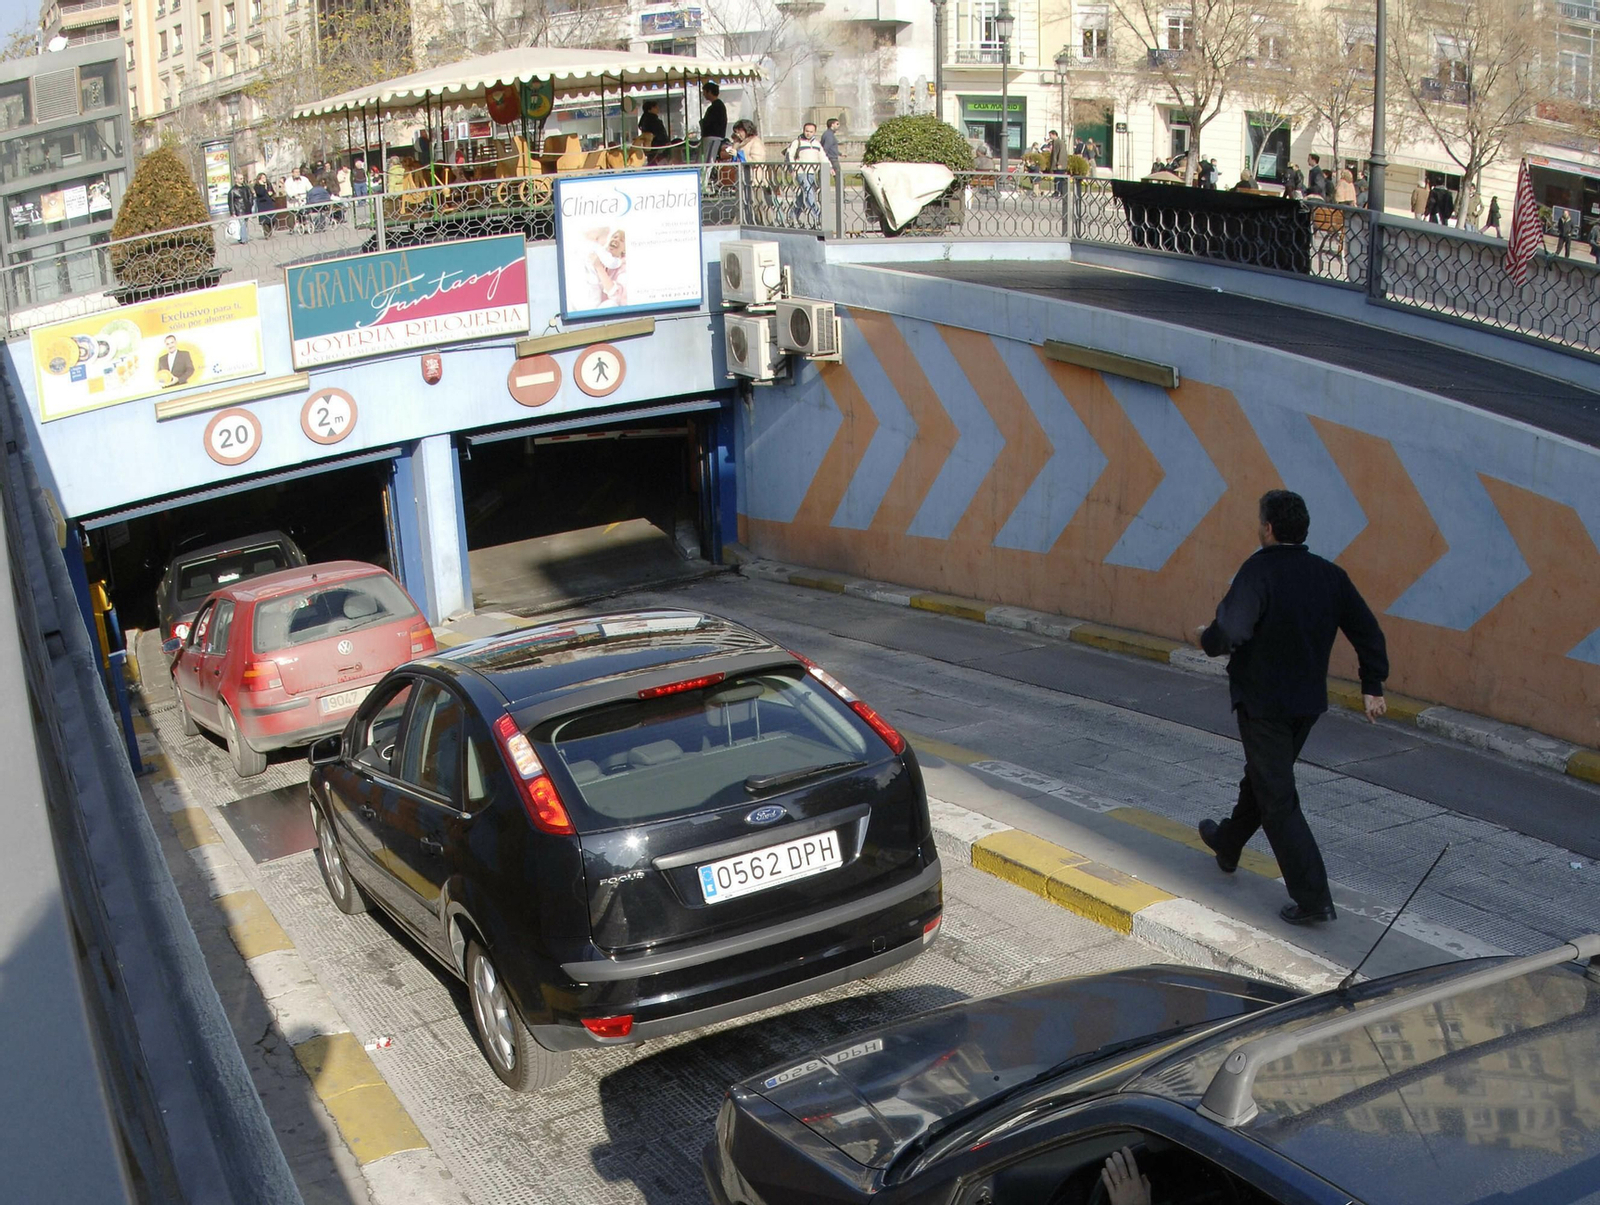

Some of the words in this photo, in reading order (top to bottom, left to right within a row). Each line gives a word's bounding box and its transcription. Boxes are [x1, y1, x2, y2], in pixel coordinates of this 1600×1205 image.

[297, 252, 416, 309] GRANADA
[356, 256, 525, 329] Fantasy
[161, 307, 210, 324] Exclusivo
[213, 304, 231, 315] para
[188, 319, 201, 329] por
[301, 326, 395, 356] JOYERIA
[406, 308, 521, 337] RELOJERIA
[334, 414, 344, 424] m
[218, 424, 249, 449] 20
[329, 692, 357, 708] 9047
[717, 852, 782, 889] 0562
[787, 837, 835, 871] DPH
